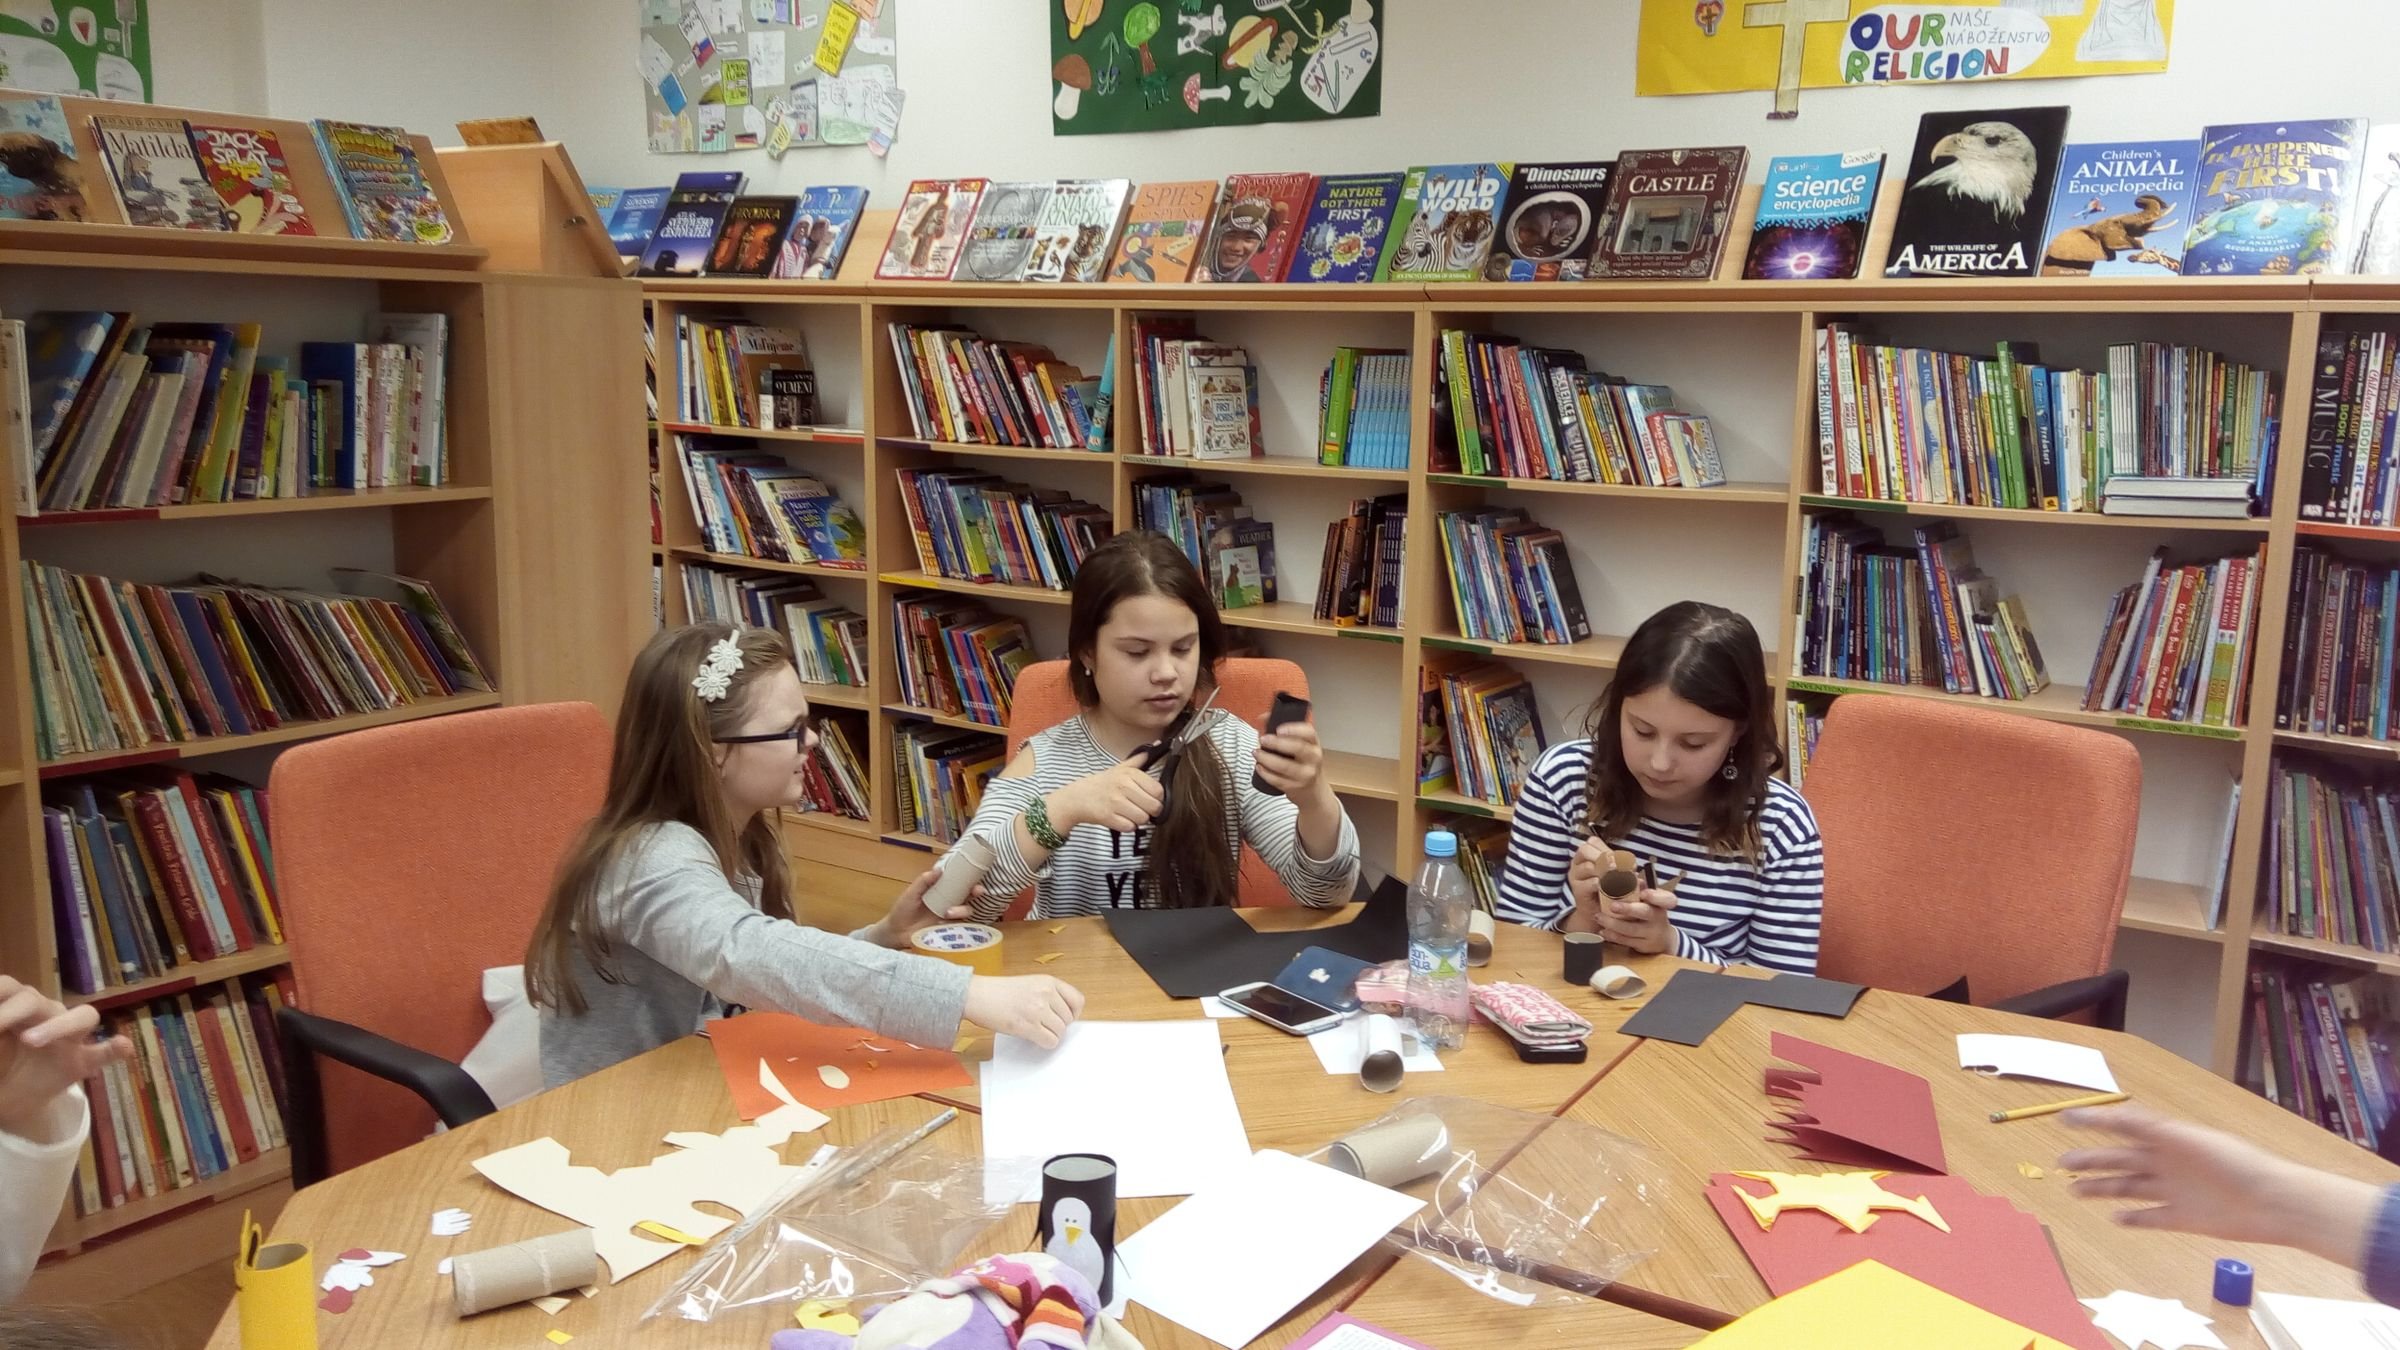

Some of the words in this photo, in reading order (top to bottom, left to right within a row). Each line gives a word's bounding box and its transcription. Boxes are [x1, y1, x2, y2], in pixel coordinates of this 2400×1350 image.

[1950, 10, 1992, 27] NAŠE
[1850, 13, 1947, 51] OUR
[1945, 28, 2050, 46] NÁBOŽENSTVO
[1845, 47, 2010, 83] RELIGION
[107, 132, 192, 160] Matilda
[206, 129, 266, 149] JACK
[211, 149, 270, 168] SPLAT
[2102, 149, 2162, 161] Children's
[2243, 153, 2311, 169] HERE
[1527, 167, 1607, 183] Dinosaurs
[2073, 160, 2184, 178] ANIMAL
[1427, 178, 1500, 199] WILD
[1629, 174, 1717, 194] CASTLE
[1775, 174, 1867, 198] science
[2068, 179, 2184, 196] Encyclopedia
[2208, 166, 2341, 196] FIRST!
[1142, 184, 1205, 208] SPIES
[1329, 186, 1383, 199] NATURE
[1773, 193, 1860, 212] encyclopedia
[1320, 199, 1342, 209] GOT
[1345, 198, 1386, 208] THERE
[1422, 198, 1495, 213] WORLD
[1327, 209, 1372, 221] FIRST
[1895, 242, 2029, 271] AMERICA
[1929, 244, 1951, 252] THE
[1953, 244, 1985, 252] WILDLIFE
[1987, 243, 1999, 251] OF
[1819, 363, 1833, 440] SUPERNATURE
[2308, 387, 2340, 469] MUSIC
[2336, 403, 2349, 438] BOOK
[2359, 419, 2373, 456] BOOK
[2330, 444, 2343, 484] music
[2353, 463, 2365, 488] art
[1239, 531, 1272, 545] WEATHER
[2321, 1005, 2338, 1042] WORLD
